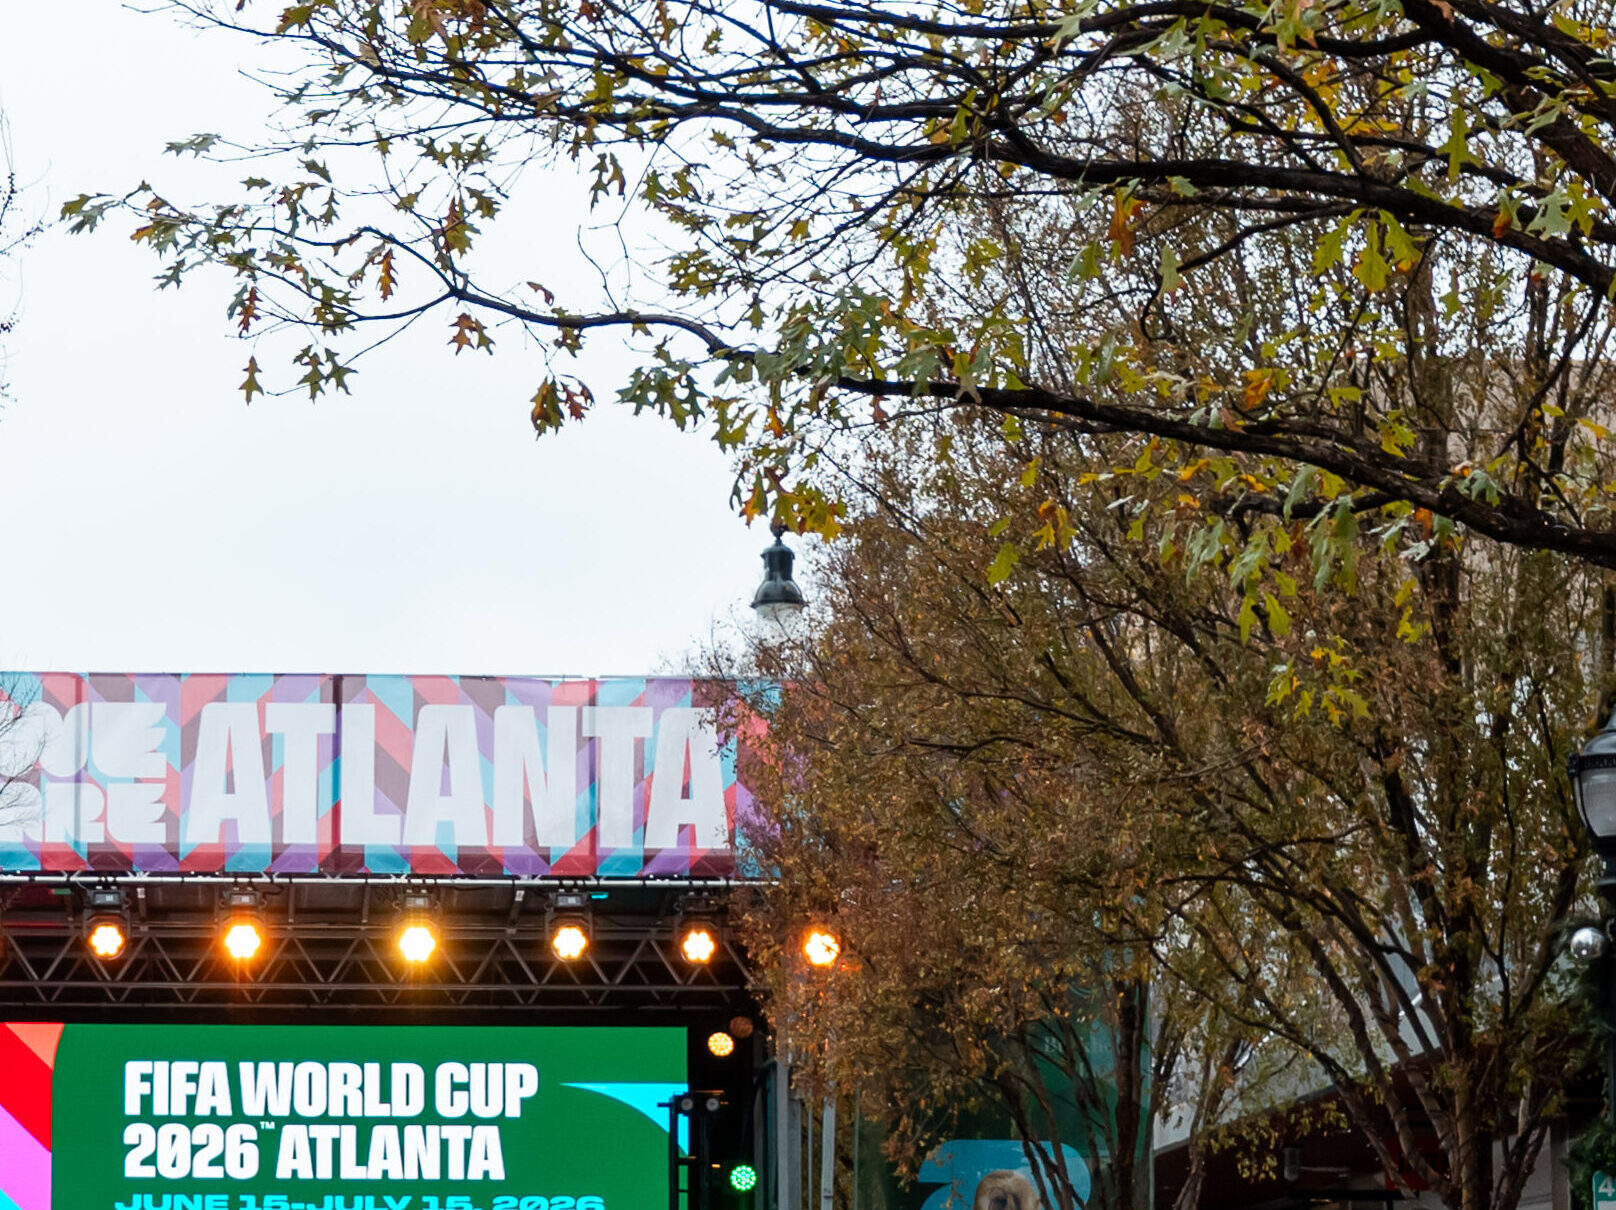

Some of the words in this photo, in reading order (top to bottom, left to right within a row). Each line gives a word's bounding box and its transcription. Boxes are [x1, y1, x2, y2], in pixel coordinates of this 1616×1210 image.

[186, 702, 732, 849] ATLANTA
[124, 1061, 233, 1116] FIFA
[240, 1061, 425, 1117] WORLD
[435, 1062, 538, 1118] CUP
[276, 1124, 505, 1181] ATLANTA
